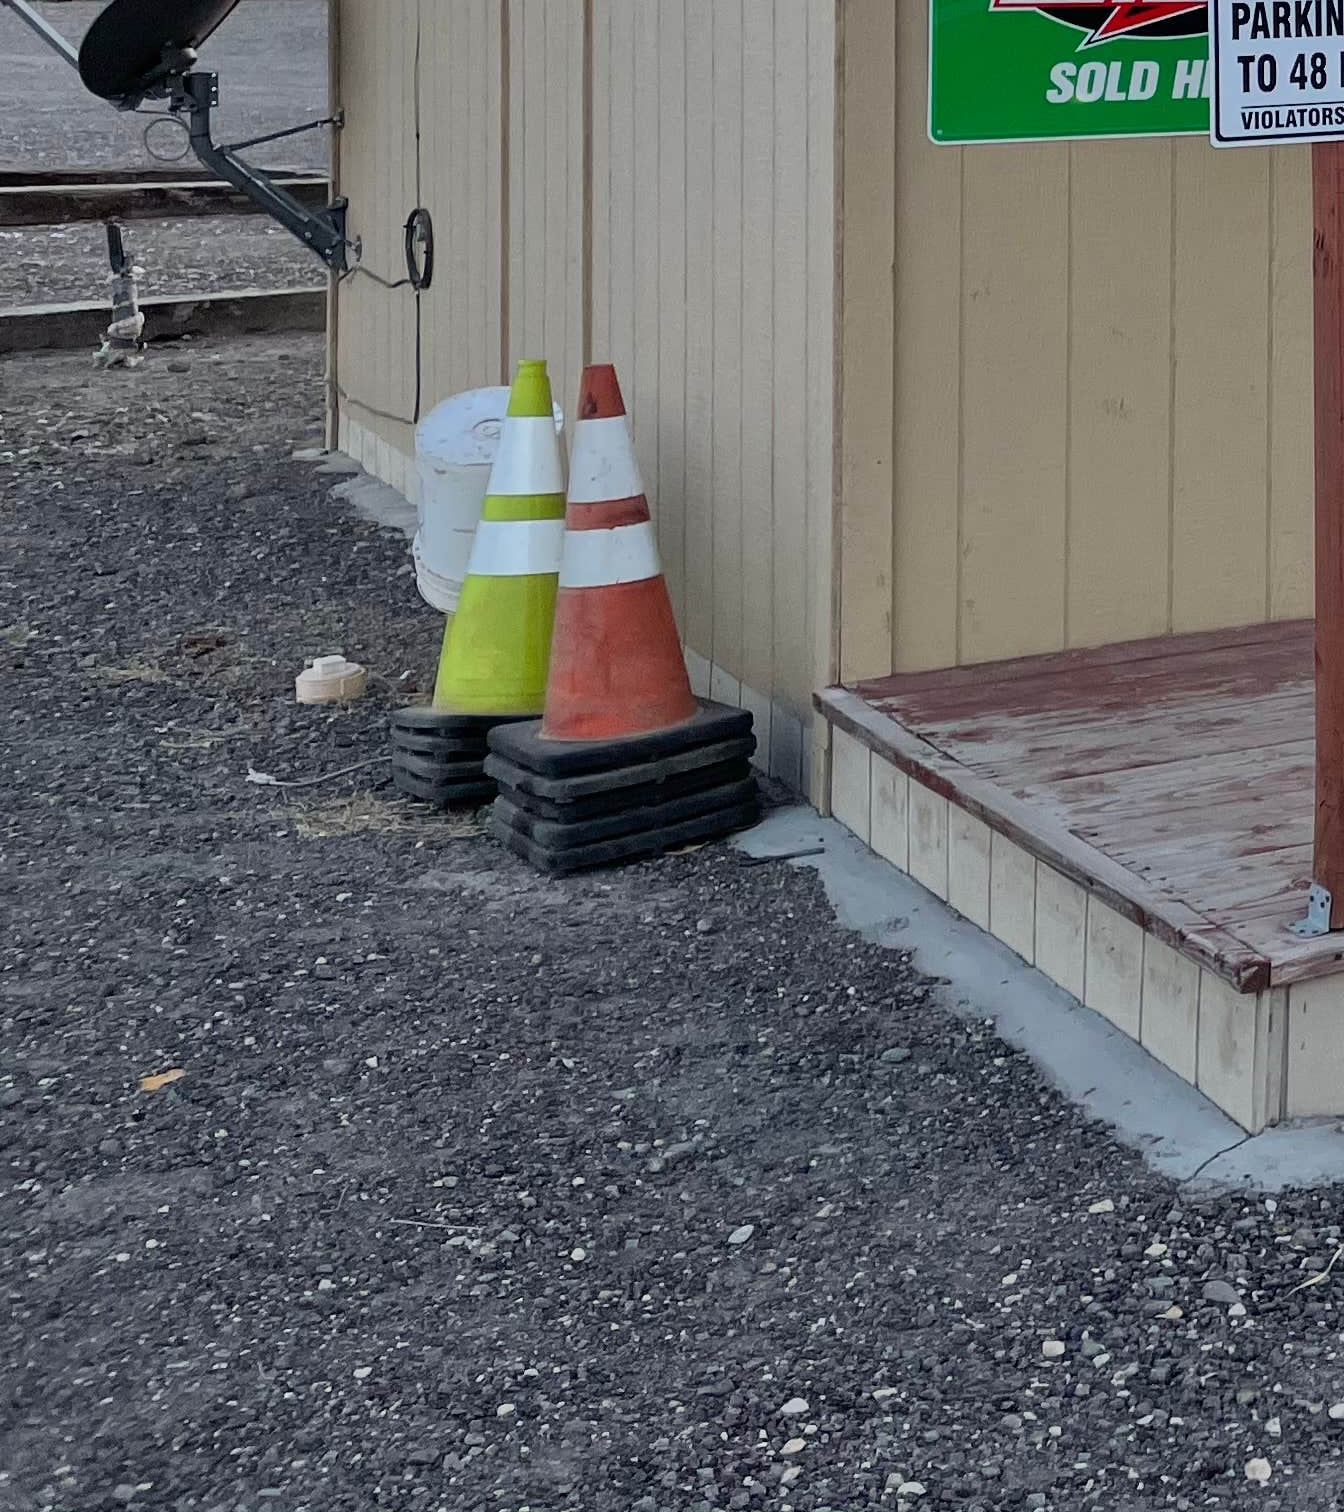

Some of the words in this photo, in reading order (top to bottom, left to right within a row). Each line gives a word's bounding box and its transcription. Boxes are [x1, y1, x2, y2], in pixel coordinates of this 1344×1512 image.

[1045, 60, 1160, 104] SOLD
[1236, 53, 1277, 93] TO
[1289, 51, 1328, 91] 48
[1240, 105, 1344, 130] VIOLATORS
